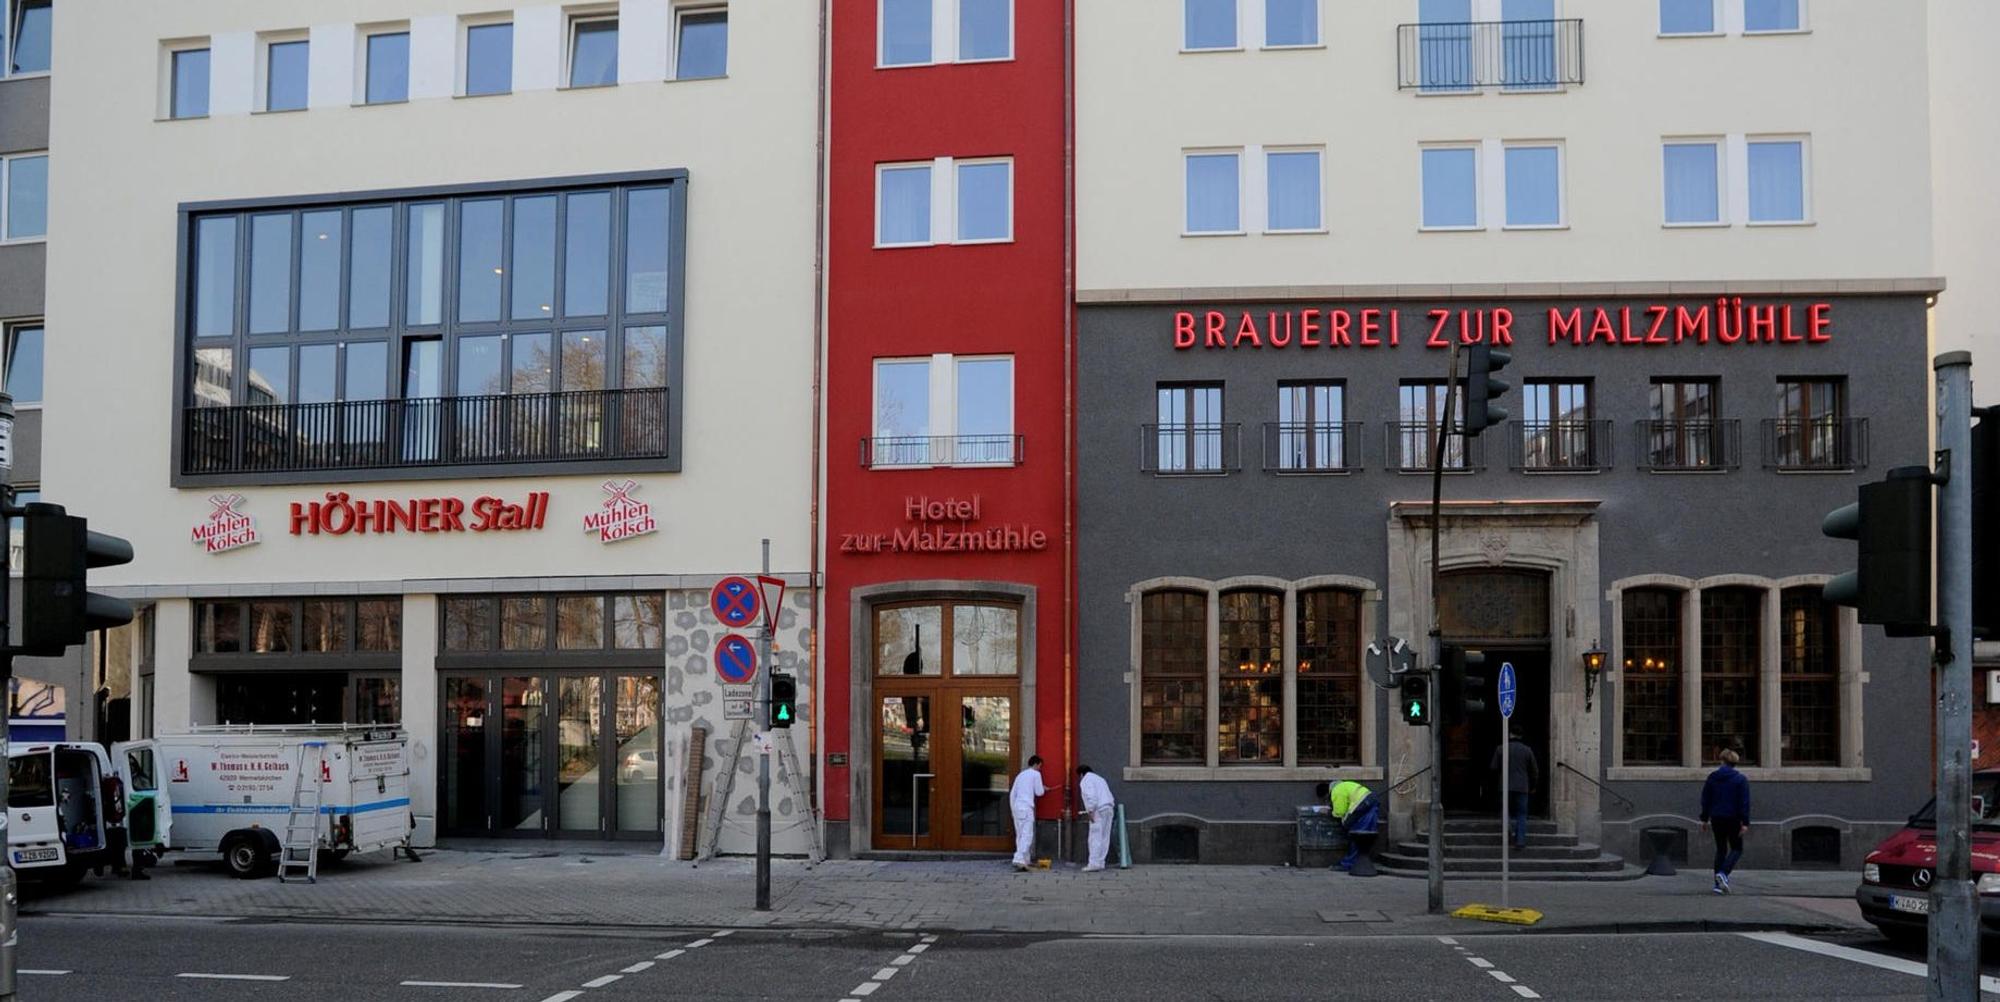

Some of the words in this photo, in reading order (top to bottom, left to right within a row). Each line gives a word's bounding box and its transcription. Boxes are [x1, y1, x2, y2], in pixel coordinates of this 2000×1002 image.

[1174, 309, 1400, 349] BRAUEREI
[1426, 307, 1513, 347] ZUR
[1547, 296, 1832, 346] MALZMÜHLE
[290, 492, 465, 535] HÖHNER
[470, 492, 549, 531] Stall
[584, 504, 648, 529] Mühlen
[905, 493, 980, 520] Hotel
[192, 517, 250, 540] Mühlen
[207, 528, 255, 552] Kölsch
[601, 516, 655, 541] Kölsch
[840, 532, 885, 552] zur
[892, 523, 1047, 551] Malzmühle
[724, 688, 752, 698] Ladezone
[220, 762, 243, 771] Thomas
